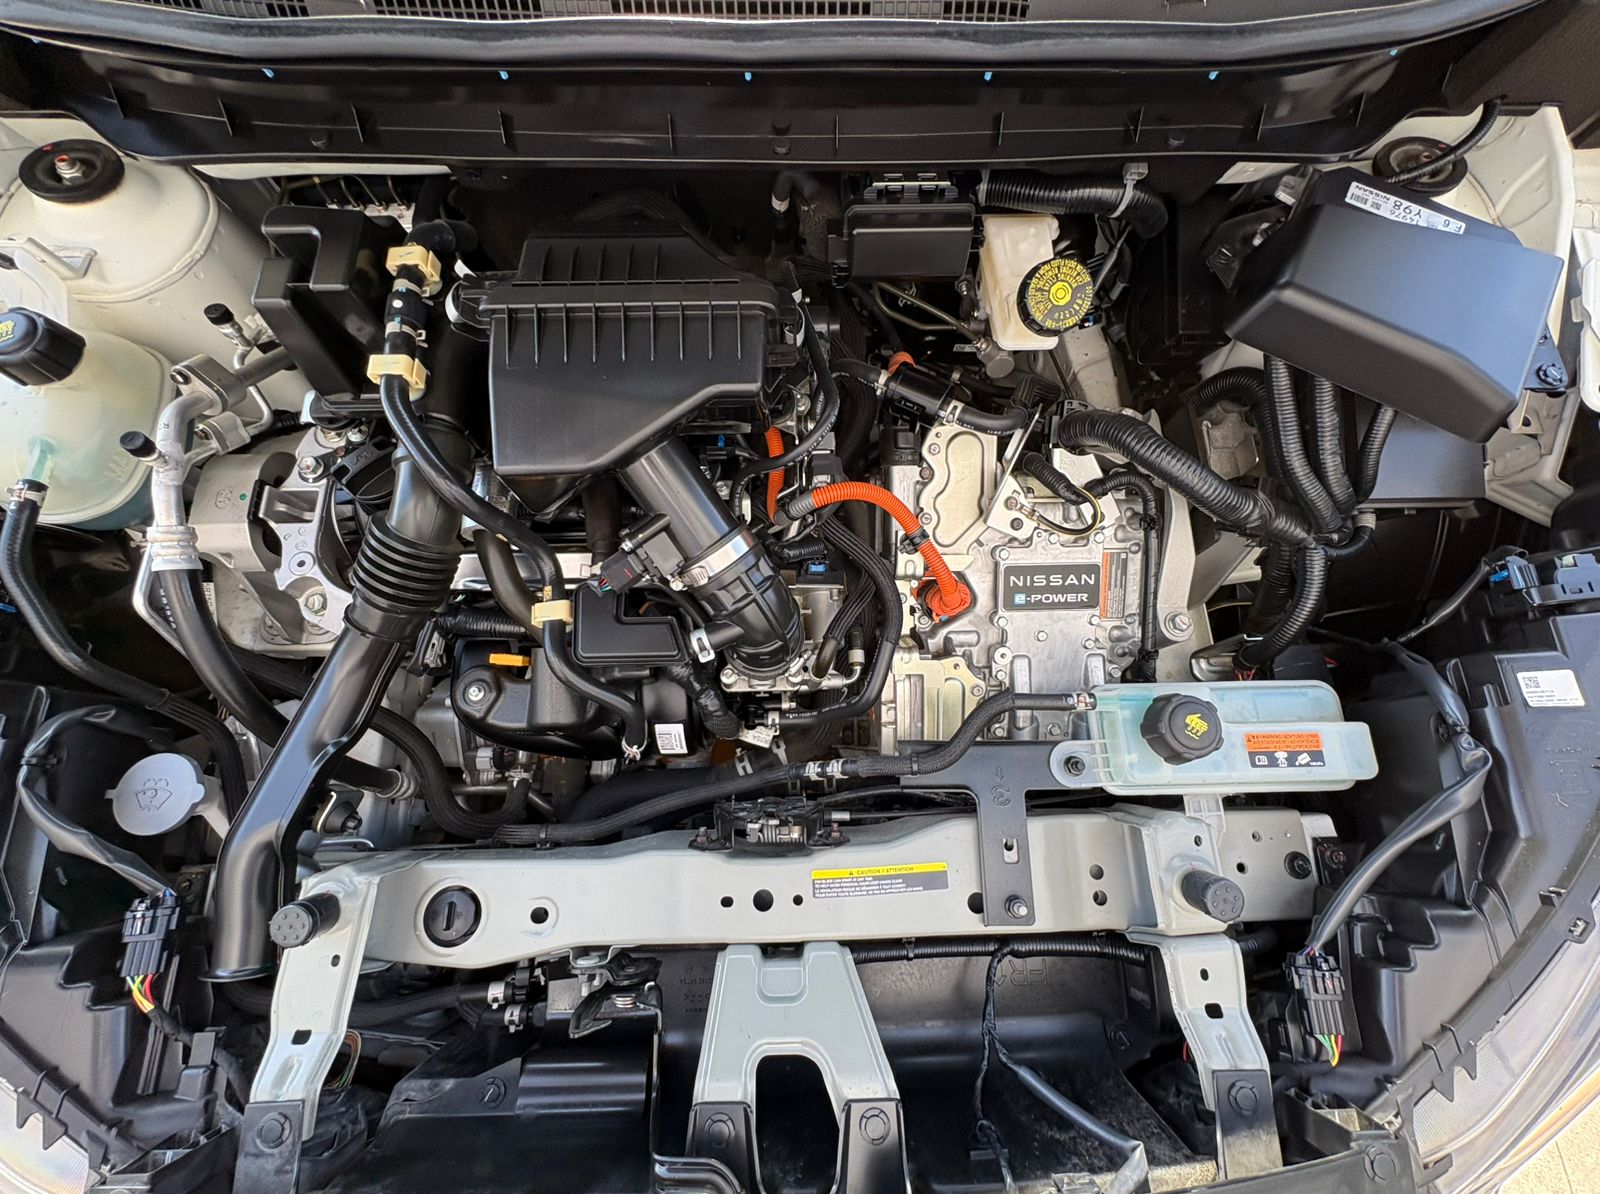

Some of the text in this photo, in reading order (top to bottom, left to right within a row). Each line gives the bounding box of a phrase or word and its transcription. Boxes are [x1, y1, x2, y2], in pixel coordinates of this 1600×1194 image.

[1354, 184, 1391, 202] NISSAN
[1392, 199, 1422, 219] Y98
[1442, 218, 1451, 229] 6
[1009, 574, 1095, 587] NISSAN
[1014, 593, 1089, 605] e-POWER
